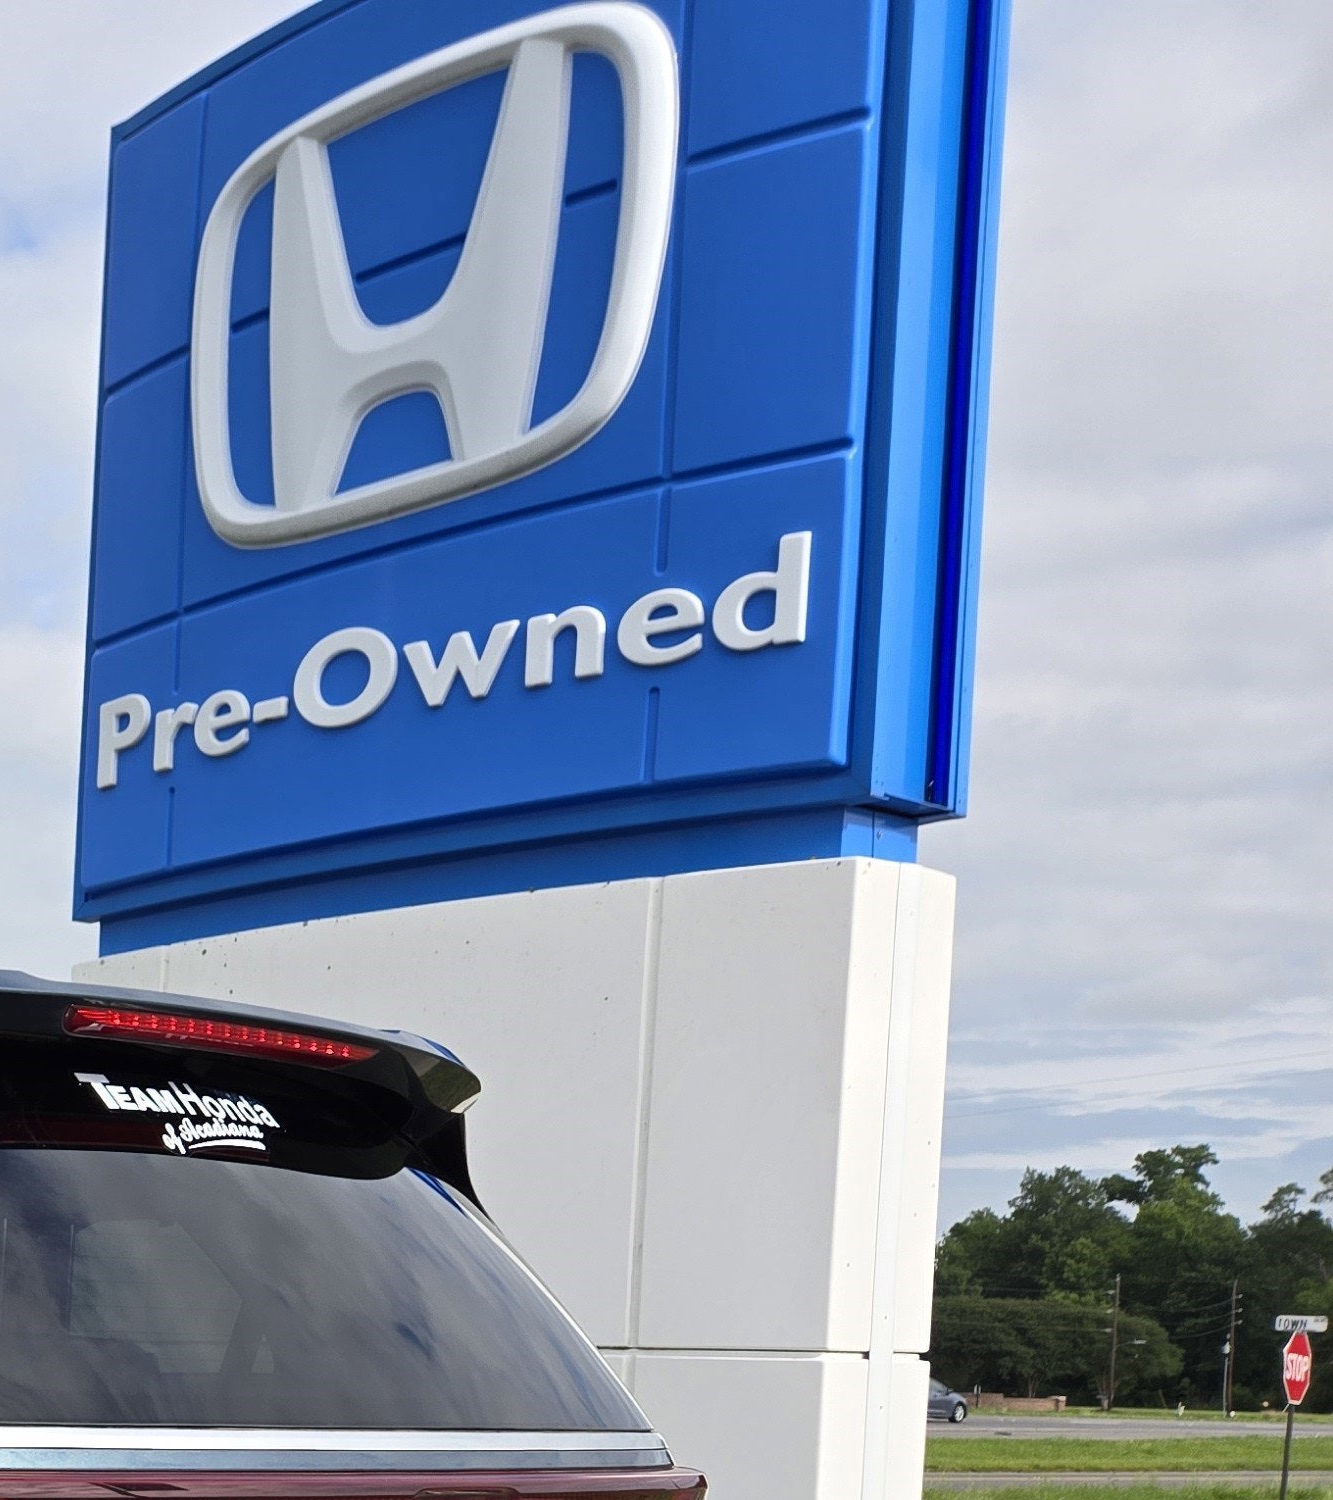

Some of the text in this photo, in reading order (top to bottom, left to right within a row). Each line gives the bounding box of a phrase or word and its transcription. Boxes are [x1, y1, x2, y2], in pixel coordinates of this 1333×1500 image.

[96, 530, 813, 790] Pre-Owned
[162, 1117, 264, 1155] of Acadiana
[1285, 1352, 1309, 1382] STOP
